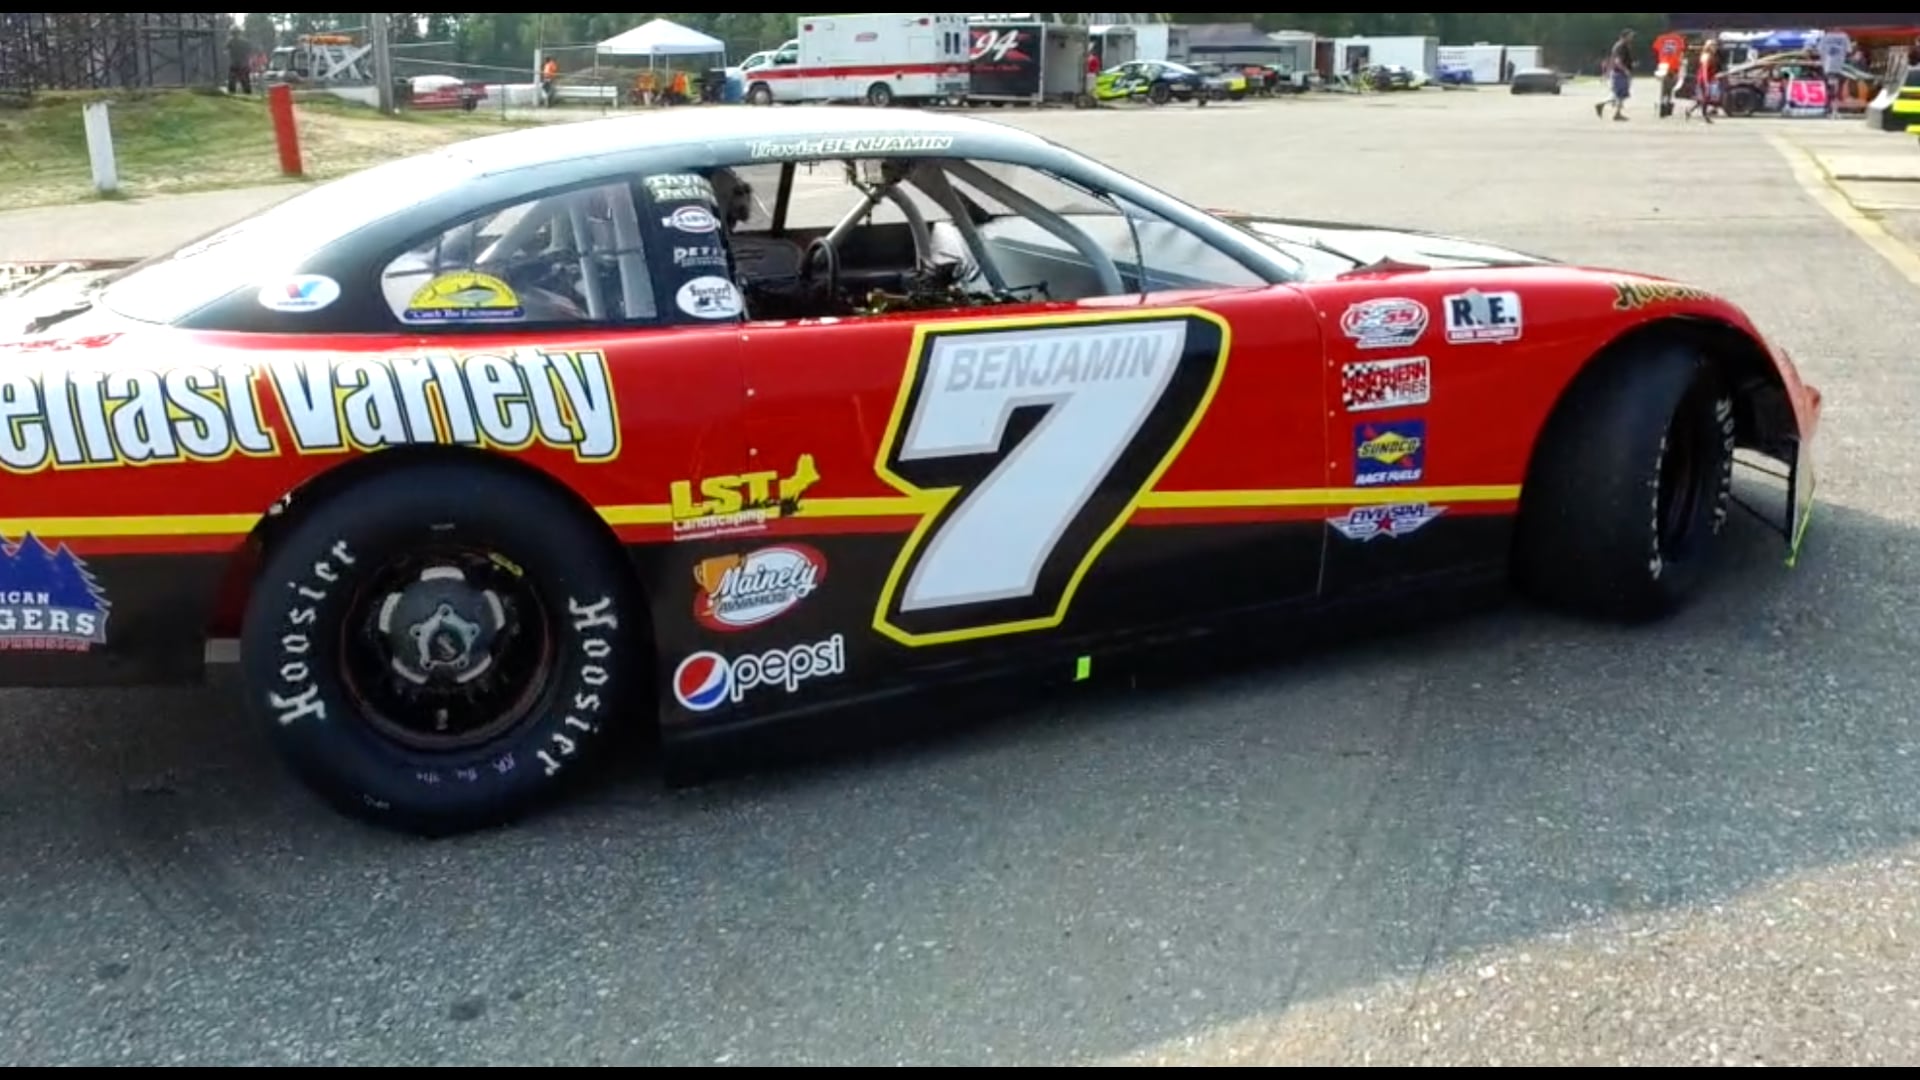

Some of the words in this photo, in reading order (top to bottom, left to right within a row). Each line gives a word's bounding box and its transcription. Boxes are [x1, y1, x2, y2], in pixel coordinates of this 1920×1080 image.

[969, 29, 1019, 61] 94
[819, 135, 954, 154] BENJAMIN
[944, 333, 1163, 393] BENJAMIN
[267, 346, 621, 462] Variety
[1361, 439, 1419, 457] SUNOCO
[886, 314, 1205, 627] 7
[1355, 471, 1386, 485] RACE
[1387, 469, 1422, 482] FUELS
[670, 470, 778, 518] LST
[0, 591, 49, 605] ICAN
[711, 561, 818, 599] Mainely
[0, 608, 95, 635] GERS
[268, 540, 356, 724] Hoosier
[536, 596, 618, 776] Hoosier
[730, 634, 846, 703] pepsi
